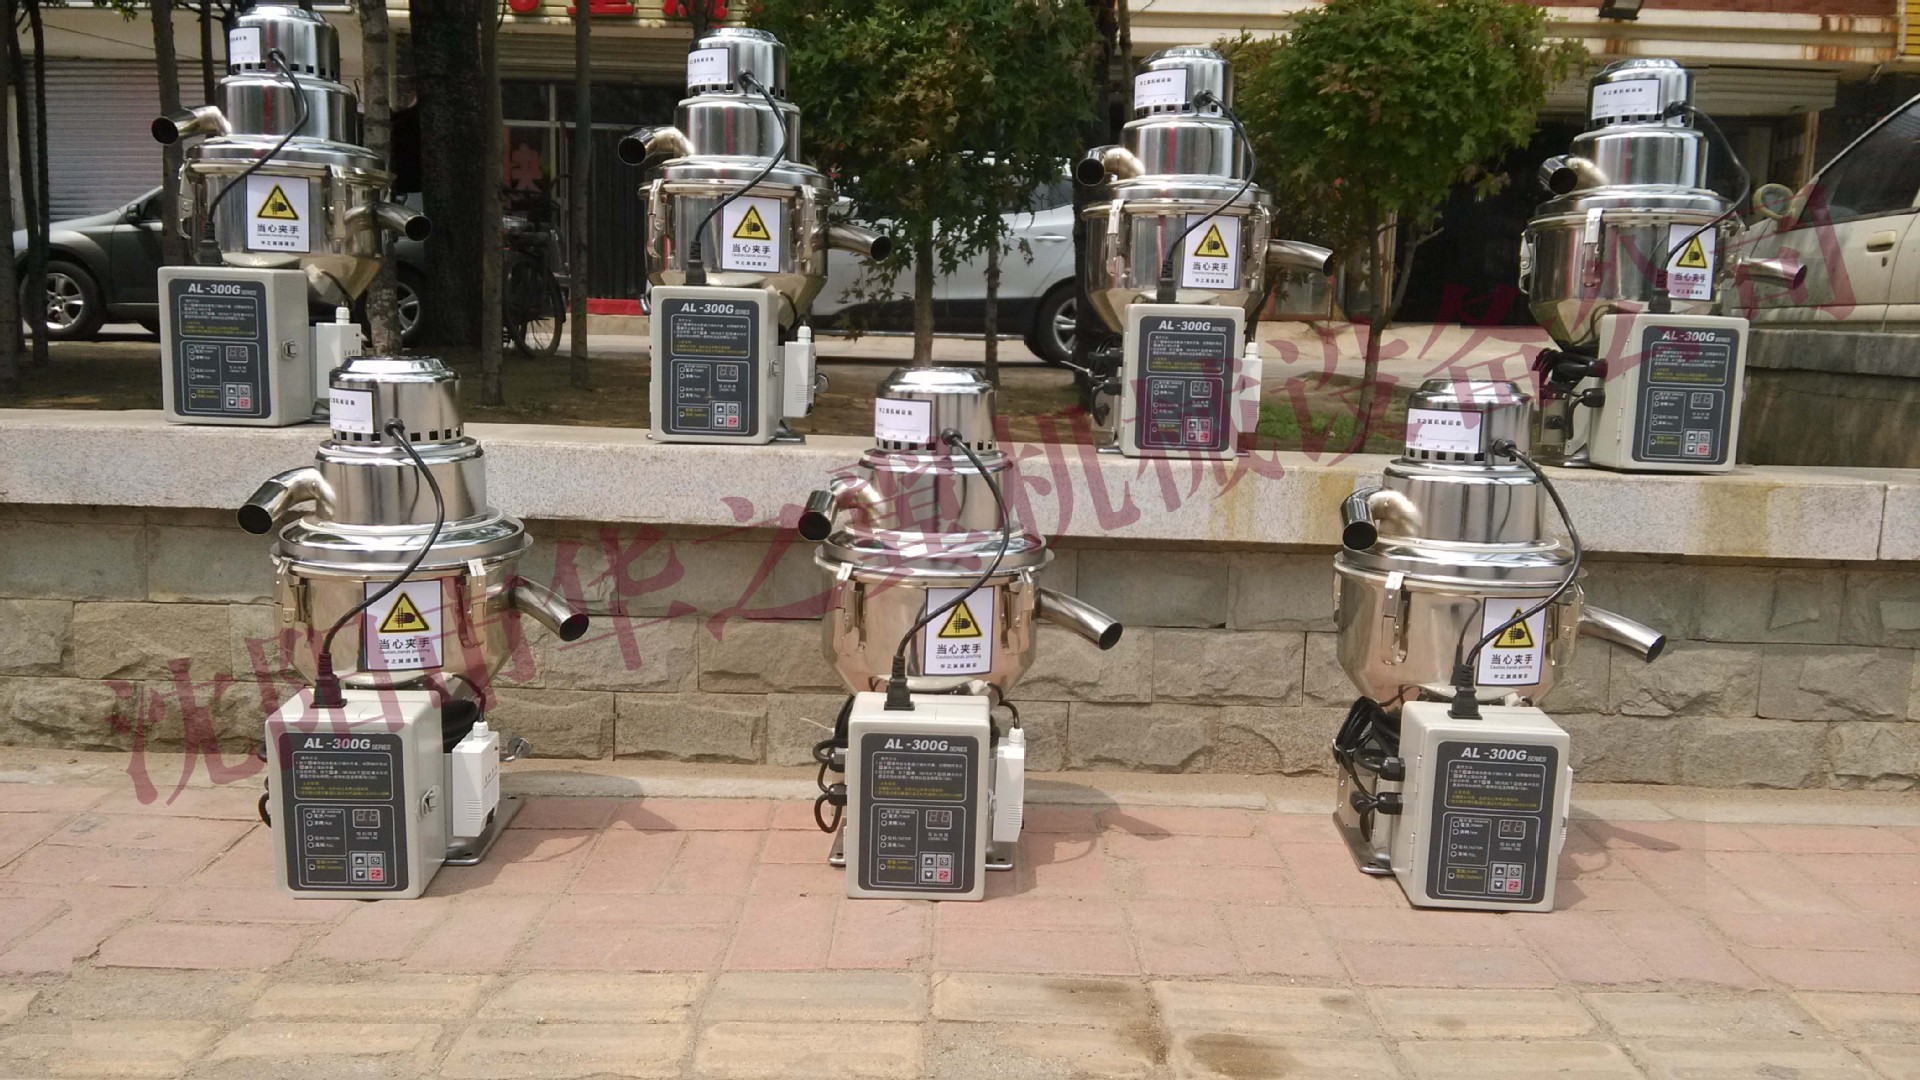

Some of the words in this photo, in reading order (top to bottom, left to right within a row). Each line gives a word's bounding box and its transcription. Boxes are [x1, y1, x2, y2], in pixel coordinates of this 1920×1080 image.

[257, 223, 299, 234] 当心夹手
[732, 243, 771, 255] 当心夹手
[1192, 260, 1229, 272] 当心夹手
[1675, 272, 1707, 283] 当心夹手
[379, 637, 430, 650] 当心夹手
[936, 643, 981, 655] 当心夹手
[1491, 654, 1533, 665] 当心夹手
[949, 745, 967, 753] SERIES
